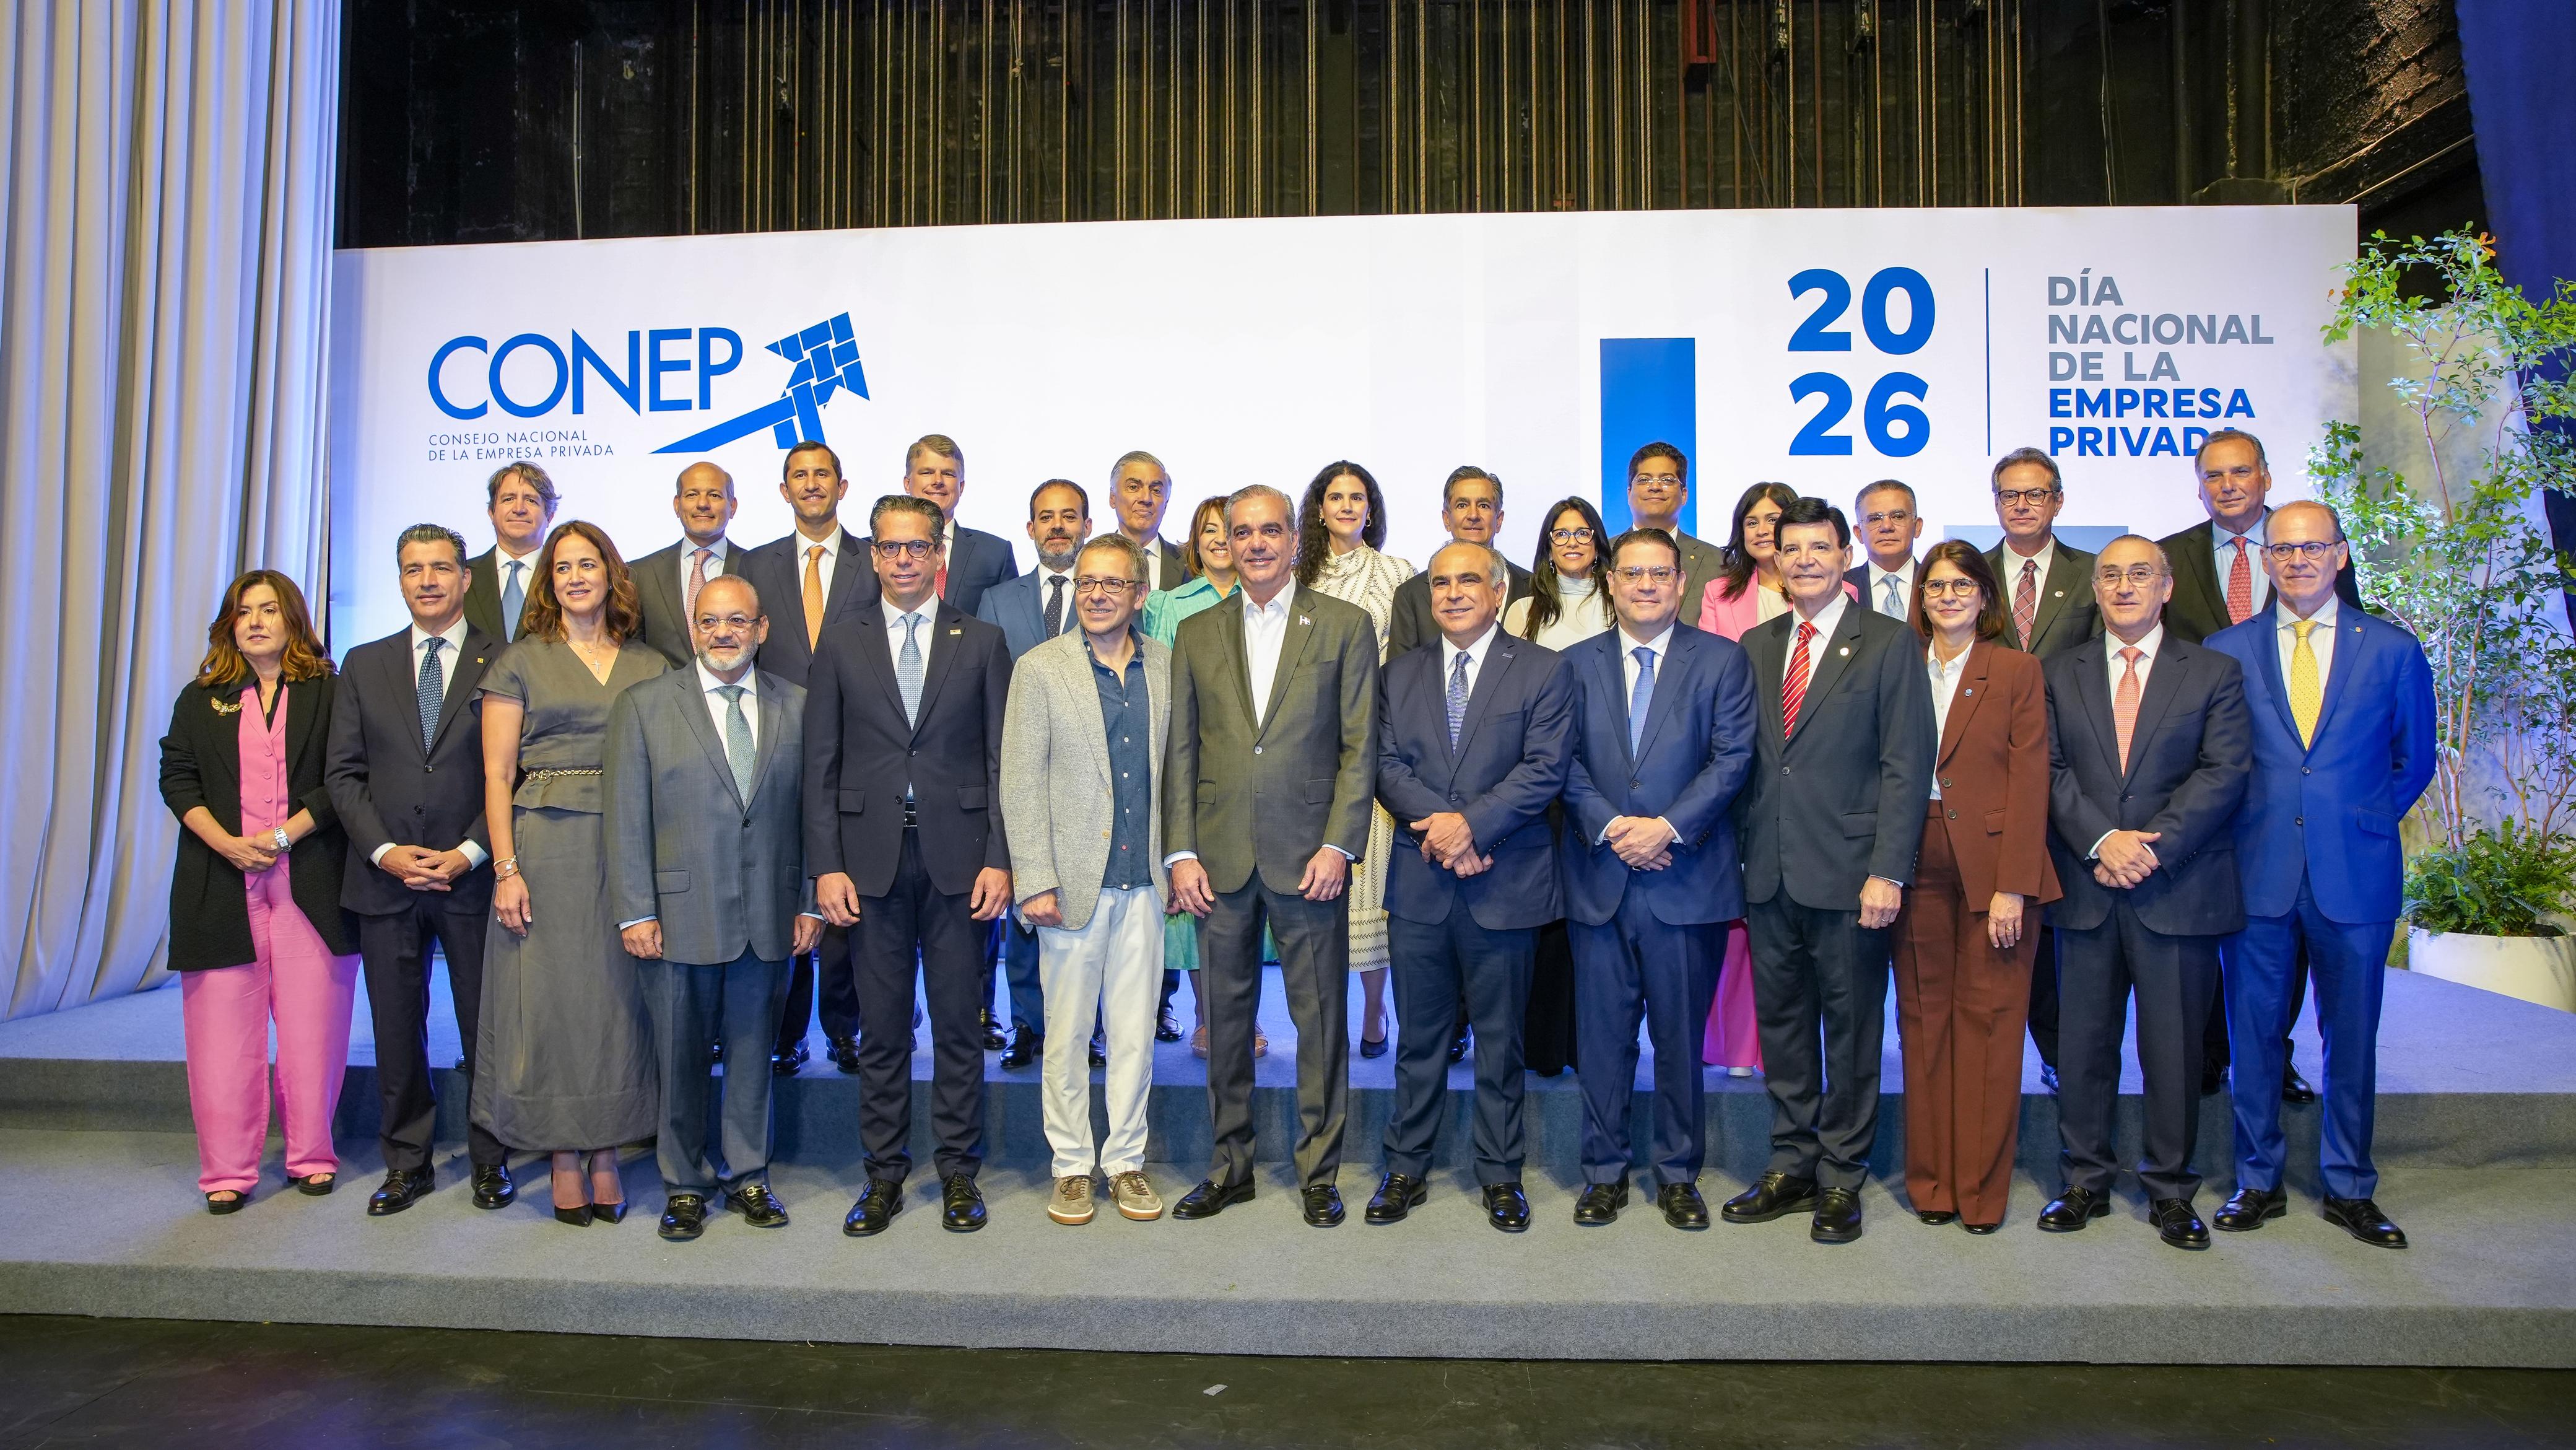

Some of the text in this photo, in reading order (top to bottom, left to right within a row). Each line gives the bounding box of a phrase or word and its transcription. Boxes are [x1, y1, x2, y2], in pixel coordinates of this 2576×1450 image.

[2048, 268, 2124, 306] DÍA
[1787, 266, 1936, 356] 20
[2048, 313, 2274, 345] NACIONAL
[427, 327, 743, 421] CONEP
[2048, 351, 2181, 382] DE LA
[1788, 372, 1930, 458] 26
[2049, 387, 2256, 419] EMPRESA
[429, 430, 588, 446] CONSEJO NACIONAL
[429, 444, 614, 461] DE LA EMPRESA PRIVADA
[2050, 426, 2237, 456] PRIVAD
